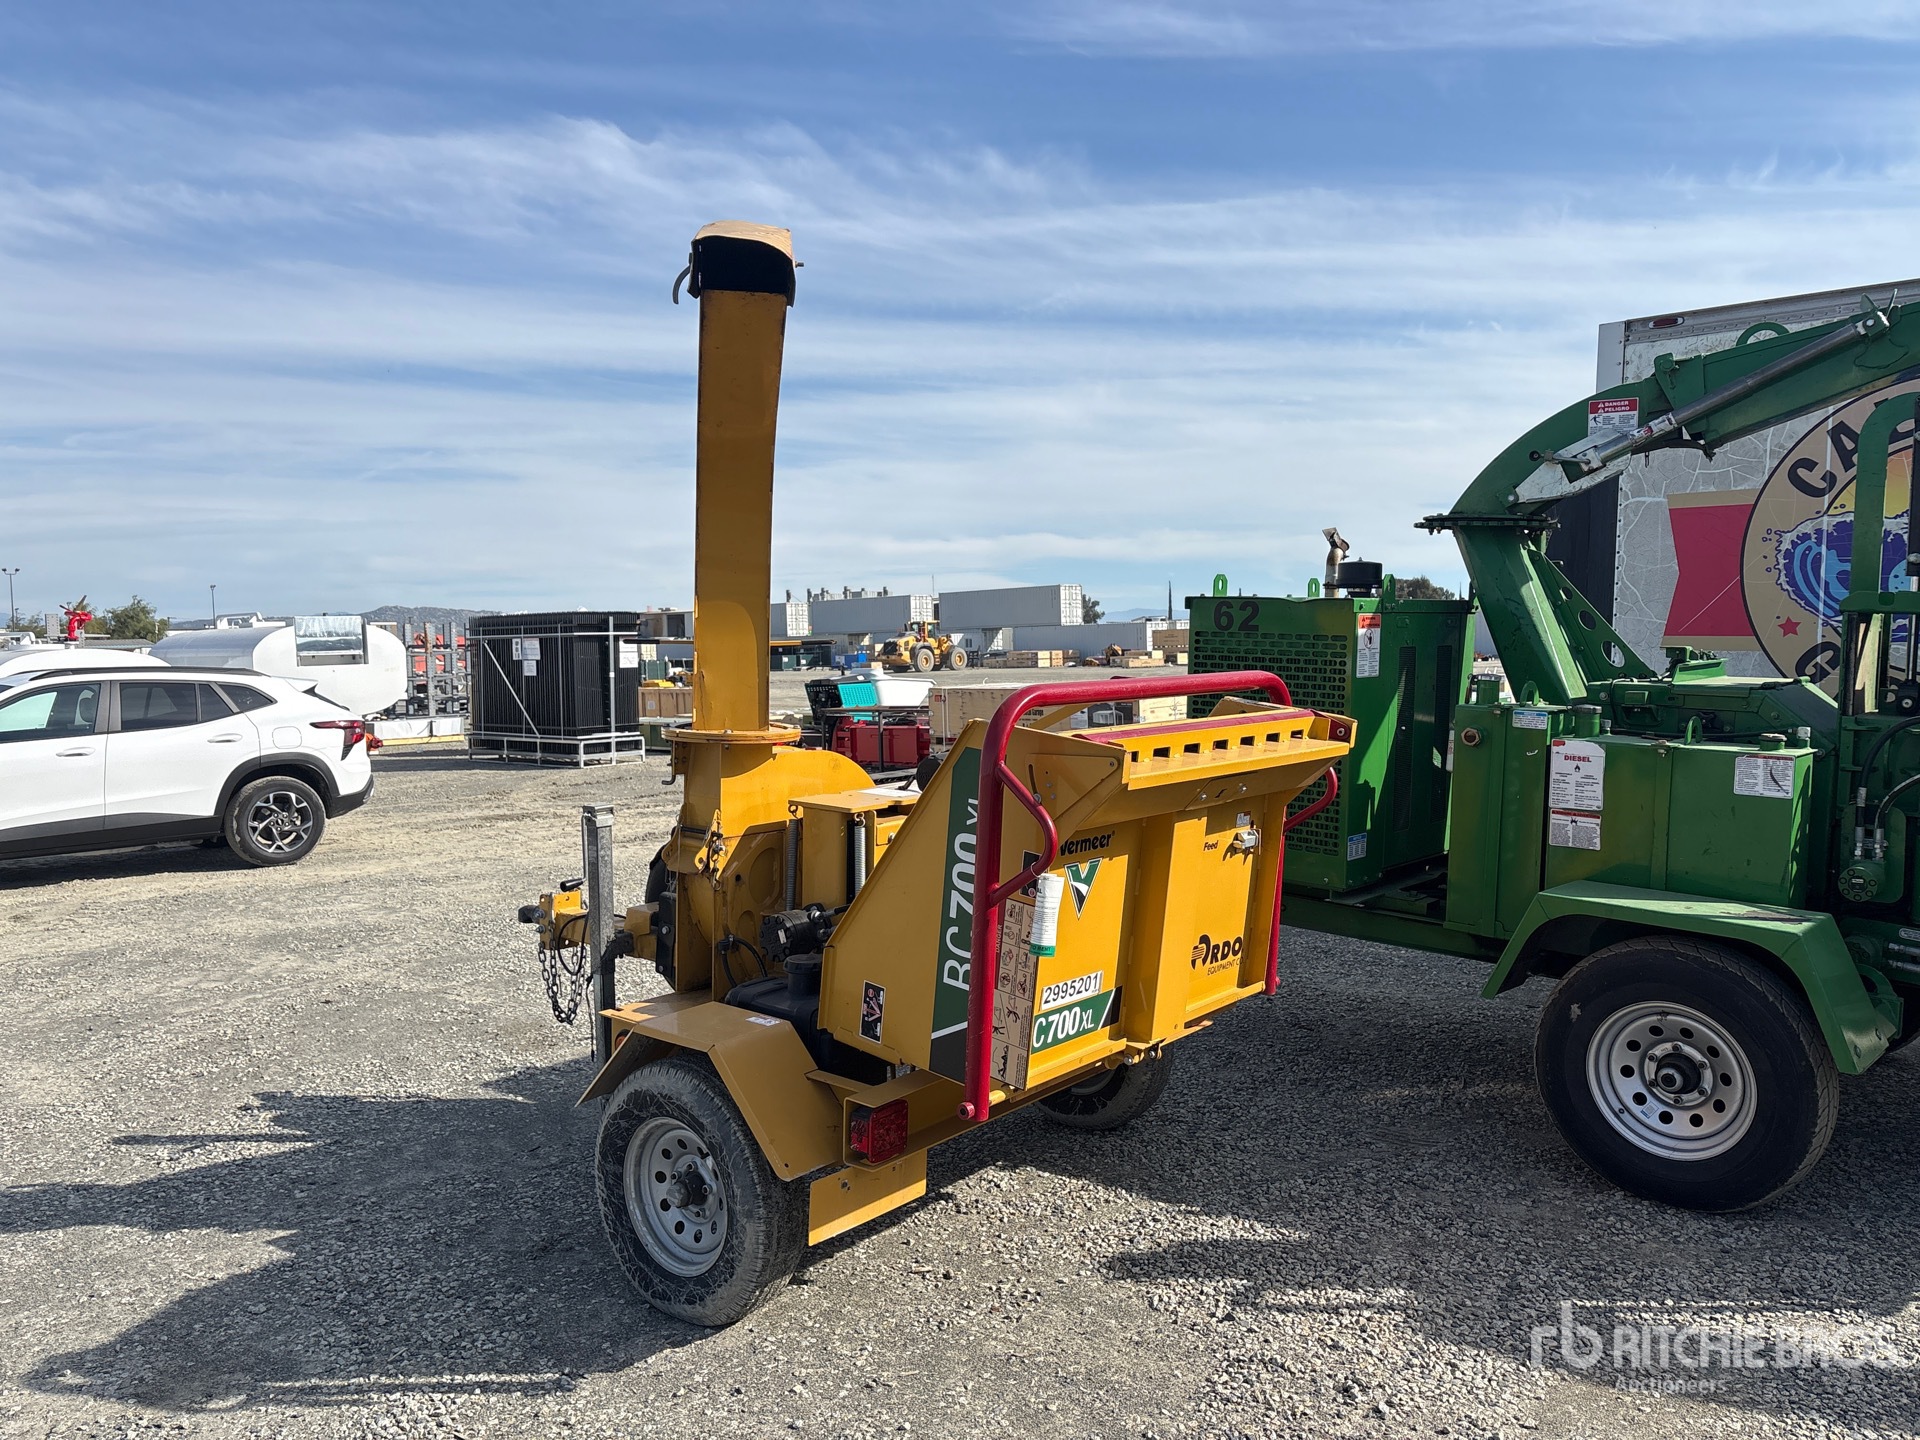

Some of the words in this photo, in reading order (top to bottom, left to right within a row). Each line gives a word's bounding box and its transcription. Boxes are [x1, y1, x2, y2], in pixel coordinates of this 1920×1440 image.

[1213, 600, 1260, 632] 62
[1563, 754, 1592, 763] DIESEL
[1060, 832, 1112, 857] Vermeer
[1203, 840, 1219, 851] Feed
[1207, 958, 1236, 976] EQUIPMENT
[1043, 973, 1099, 1004] 2995201
